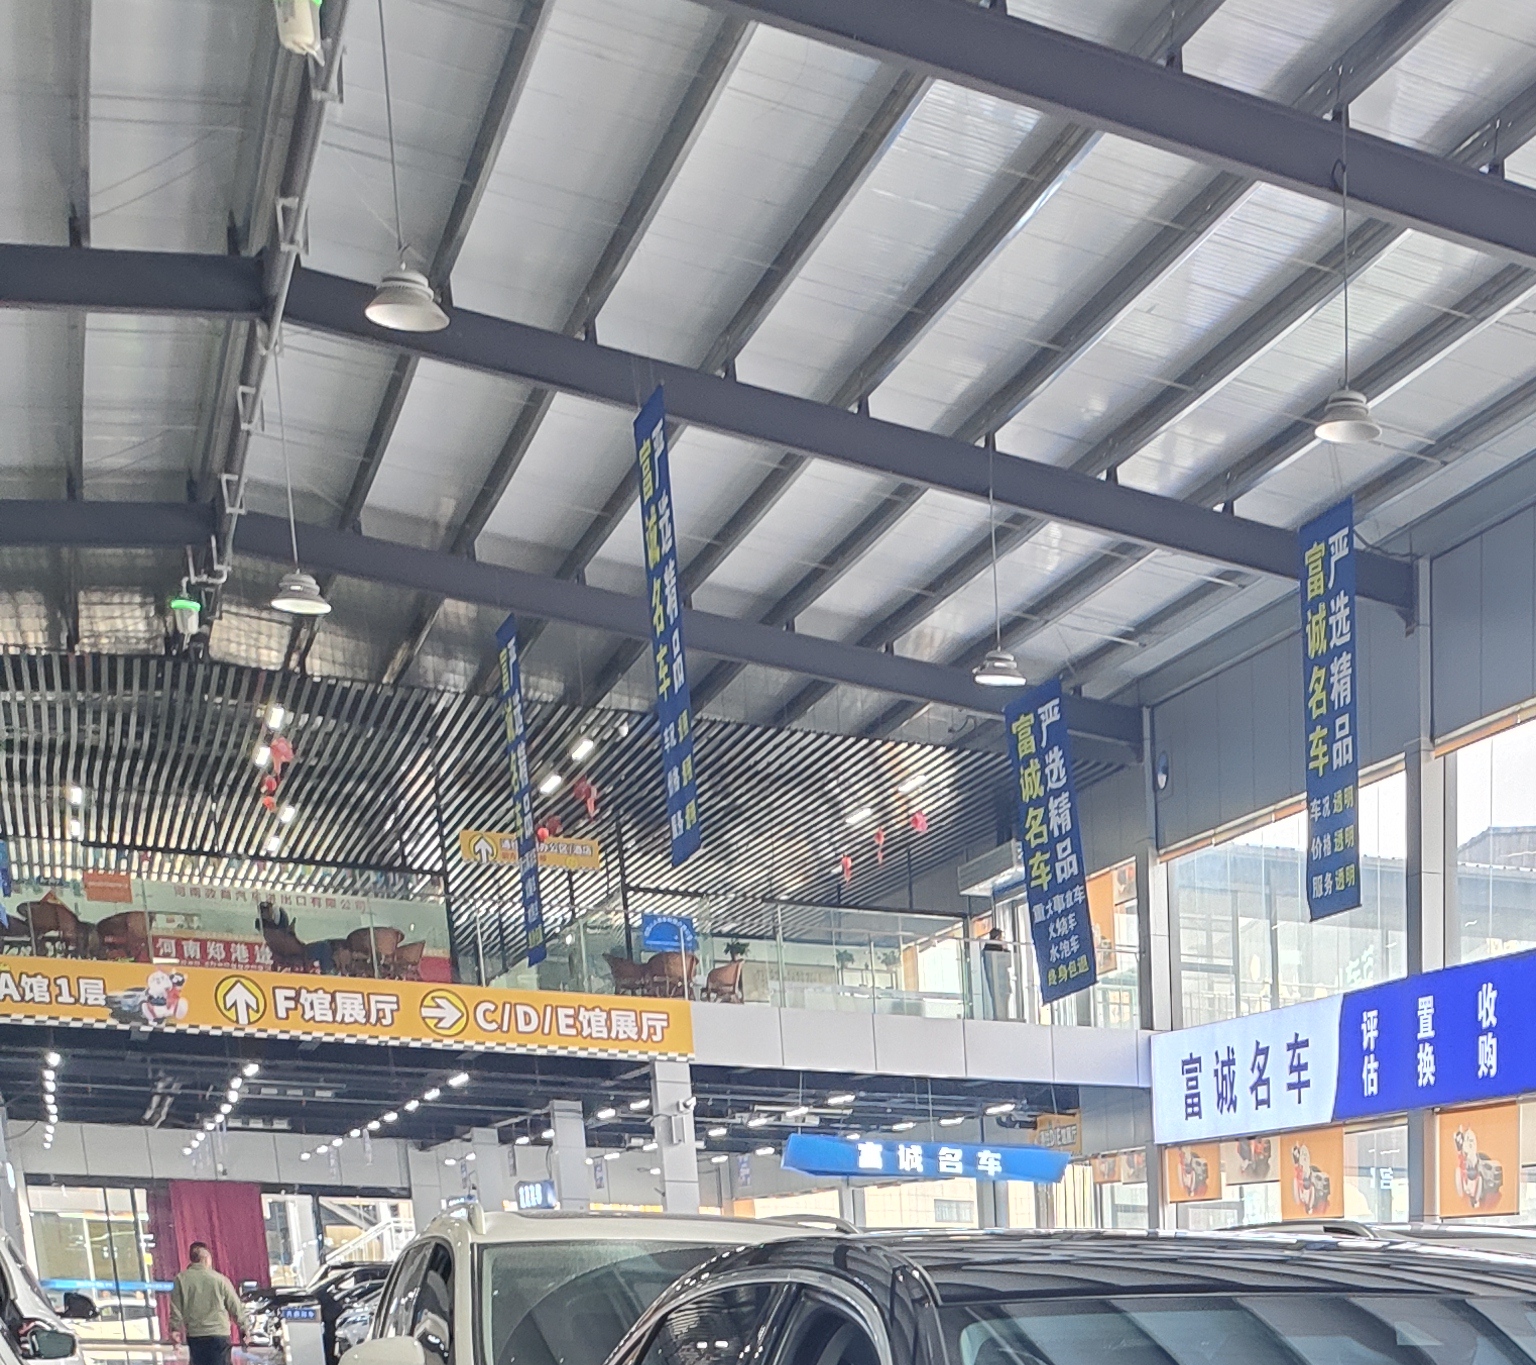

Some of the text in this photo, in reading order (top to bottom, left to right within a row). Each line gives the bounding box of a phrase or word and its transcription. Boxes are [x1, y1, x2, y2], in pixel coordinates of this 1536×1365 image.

[1304, 541, 1329, 777] 富诚名车
[1327, 526, 1352, 771] 严选精品
[1011, 713, 1052, 892] 富诚名车
[1038, 698, 1078, 884] 严选精品
[1311, 824, 1355, 860] 价格透明
[1312, 864, 1356, 899] 服务透明
[1048, 912, 1077, 940] 火烧车
[1049, 934, 1080, 962] 水泡车
[0, 972, 107, 1007] A馆1层
[273, 988, 399, 1027] F馆展厅
[473, 1000, 670, 1044] C/D/E馆展厅
[1361, 1010, 1379, 1096] 评估
[1416, 995, 1436, 1086] 置换
[1477, 982, 1498, 1078] 收购
[1181, 1032, 1311, 1121] 富诚名车
[857, 1141, 1002, 1177] 富诚名车
